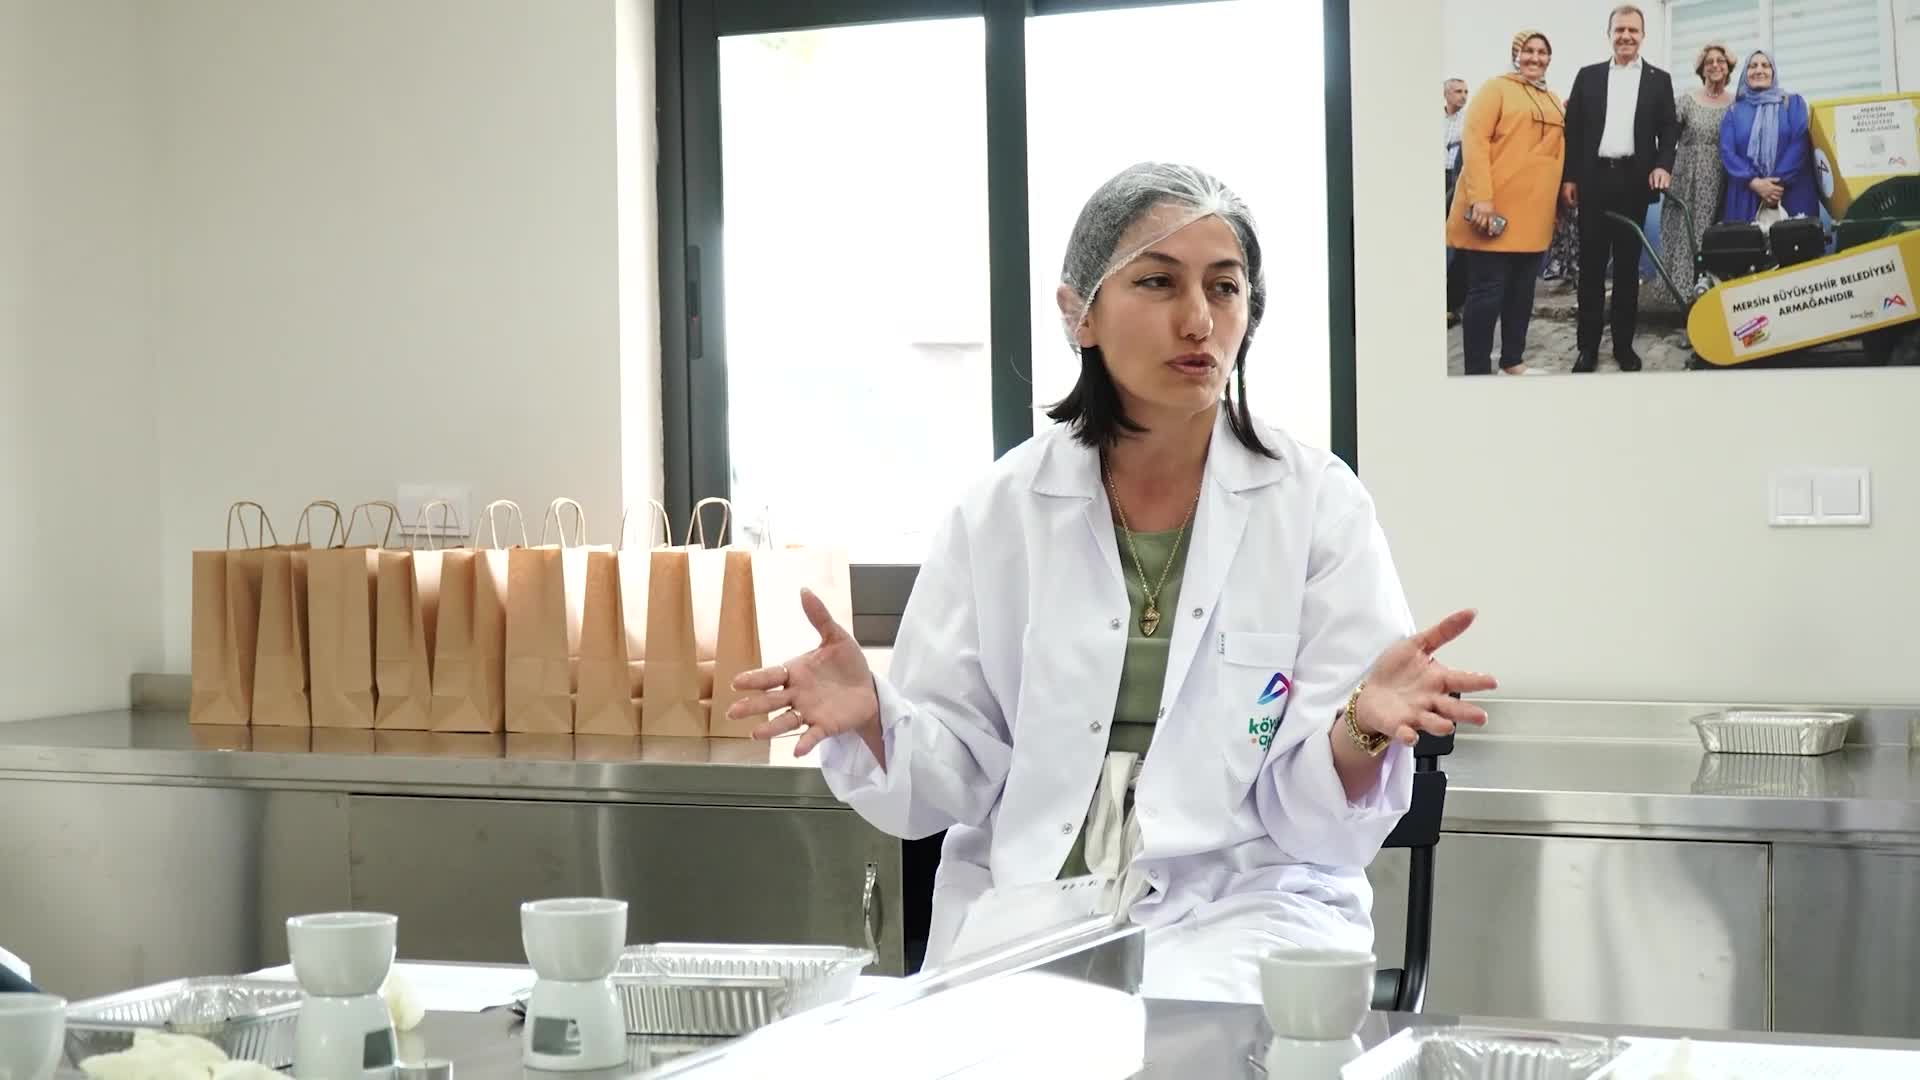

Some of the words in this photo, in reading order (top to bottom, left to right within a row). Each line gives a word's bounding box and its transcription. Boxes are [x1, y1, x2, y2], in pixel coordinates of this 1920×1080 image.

[1732, 294, 1771, 313] MERSİN
[1773, 279, 1838, 303] BÜYÜKŞEHİR
[1840, 261, 1896, 286] BELEDİYESİ
[1778, 289, 1854, 317] ARMAĞANIDIR
